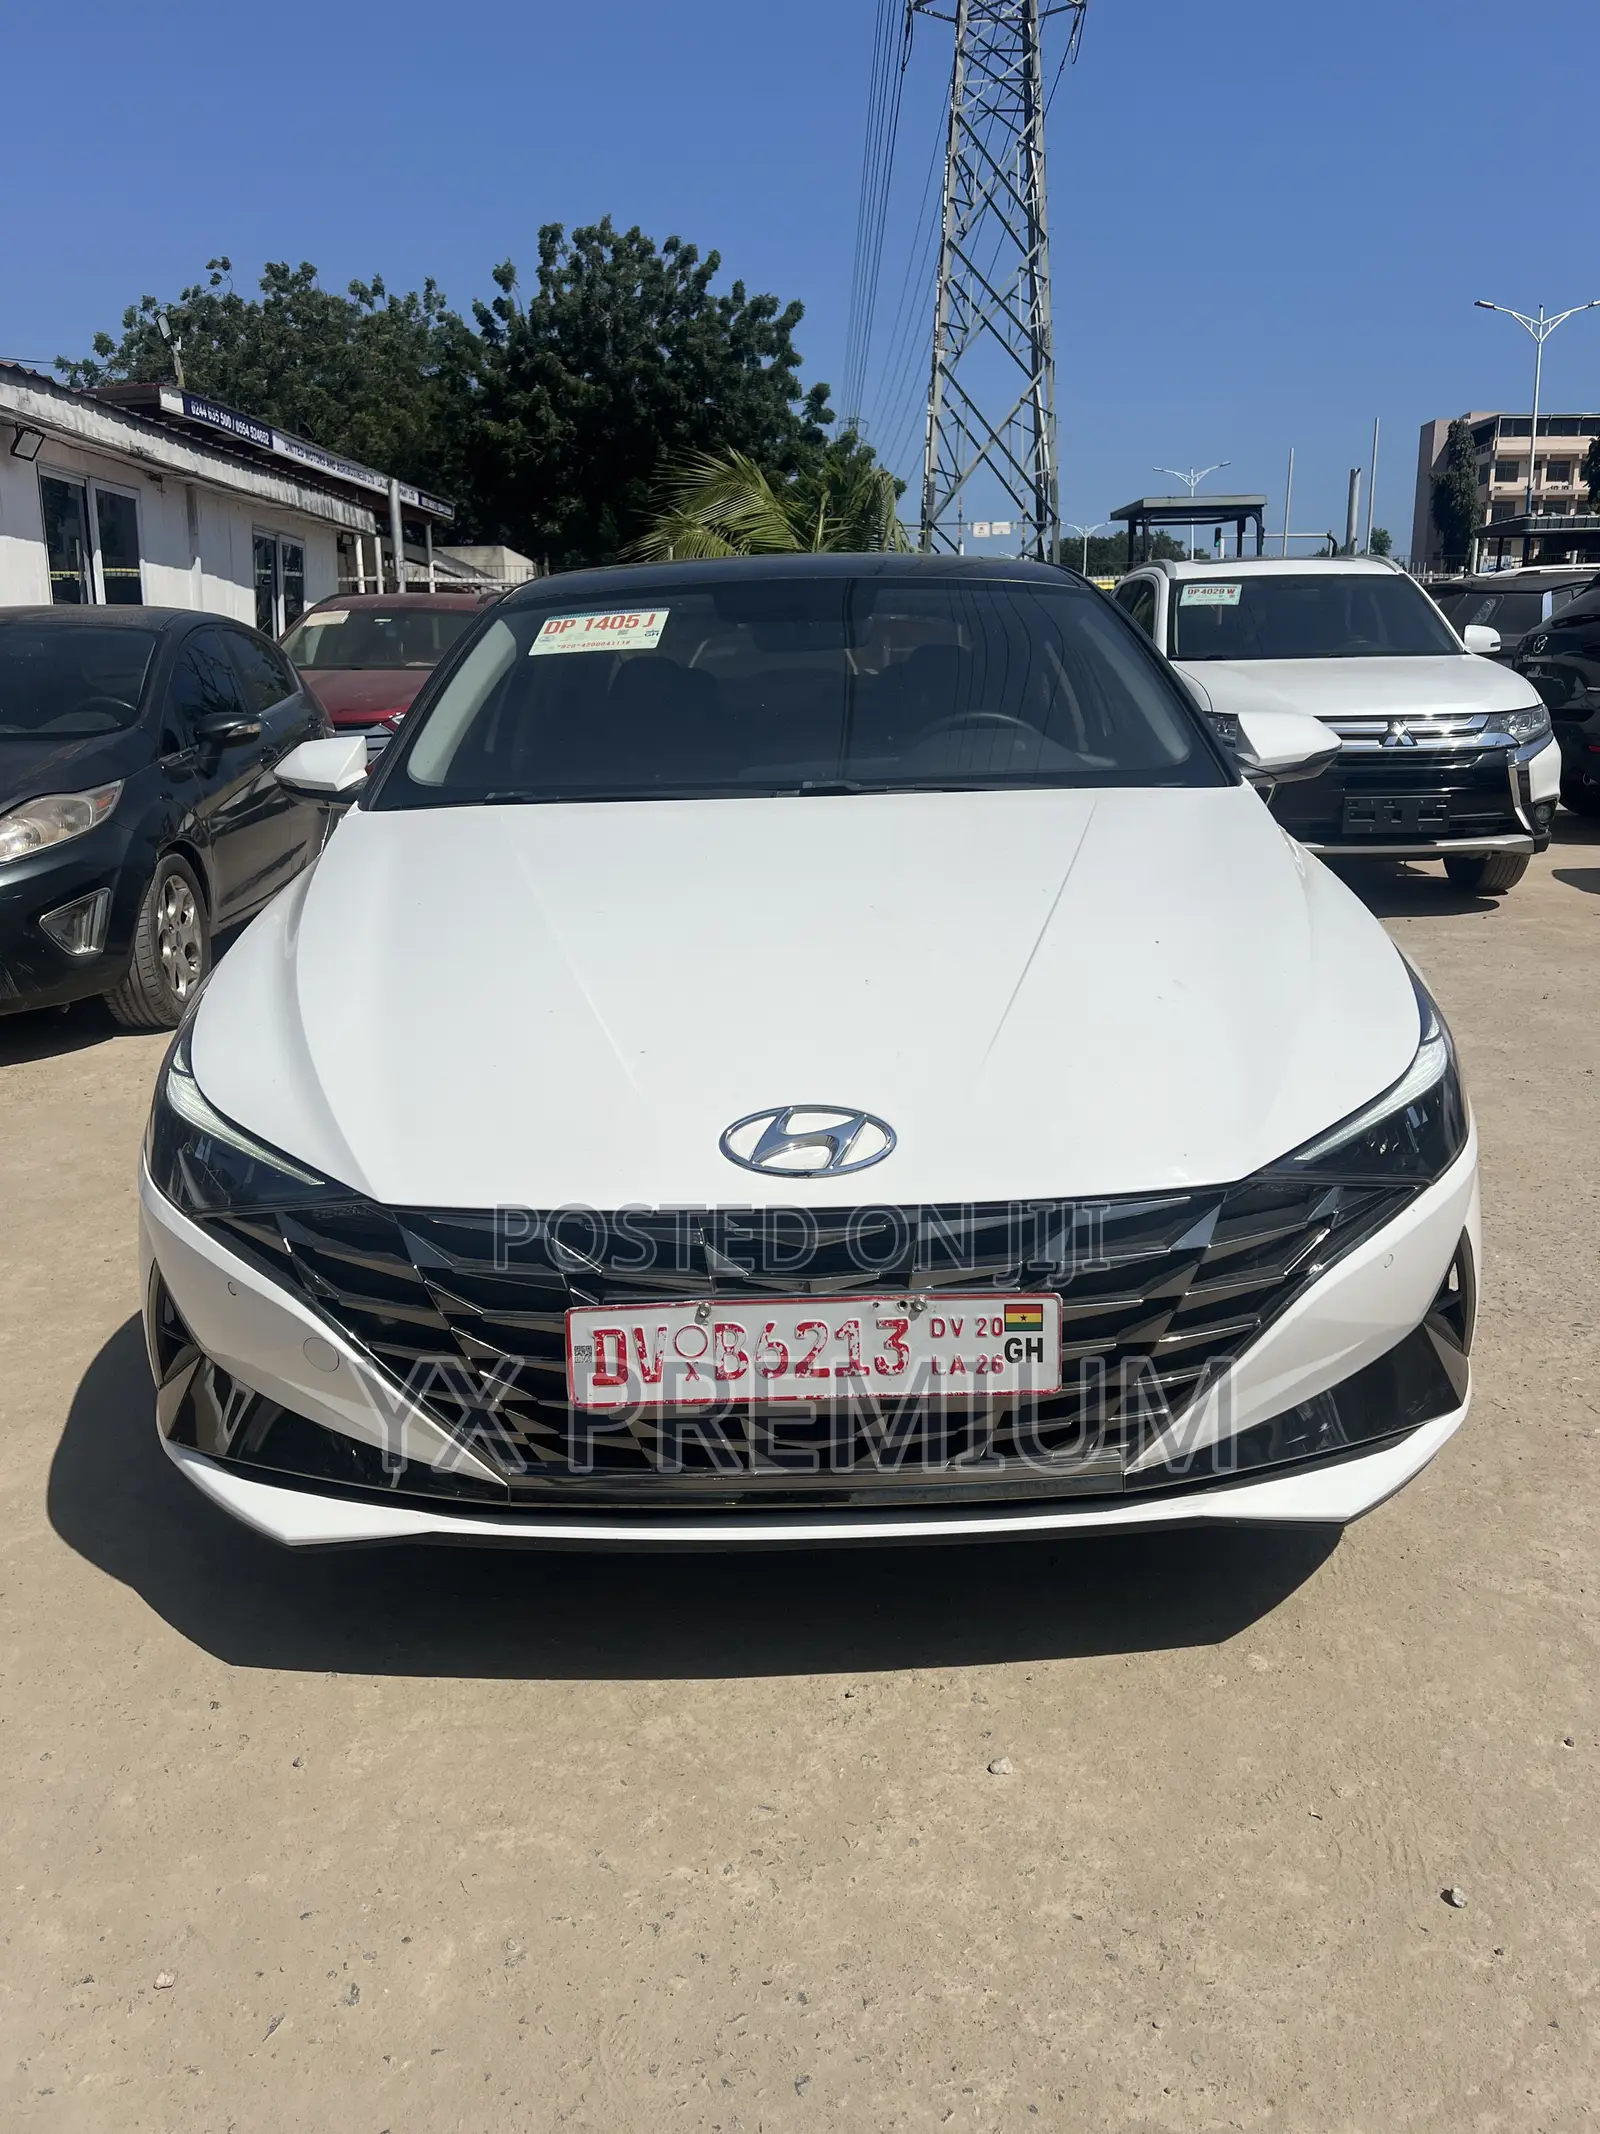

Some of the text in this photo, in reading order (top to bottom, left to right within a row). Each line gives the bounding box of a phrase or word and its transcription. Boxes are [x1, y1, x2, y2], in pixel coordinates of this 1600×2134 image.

[284, 440, 304, 458] UNITED
[544, 620, 576, 635] DP
[585, 614, 641, 632] 1405
[930, 1316, 1004, 1338] DV 20
[592, 1318, 911, 1387] DV B6213
[1004, 1337, 1044, 1364] GH
[930, 1354, 1005, 1376] LA 26
